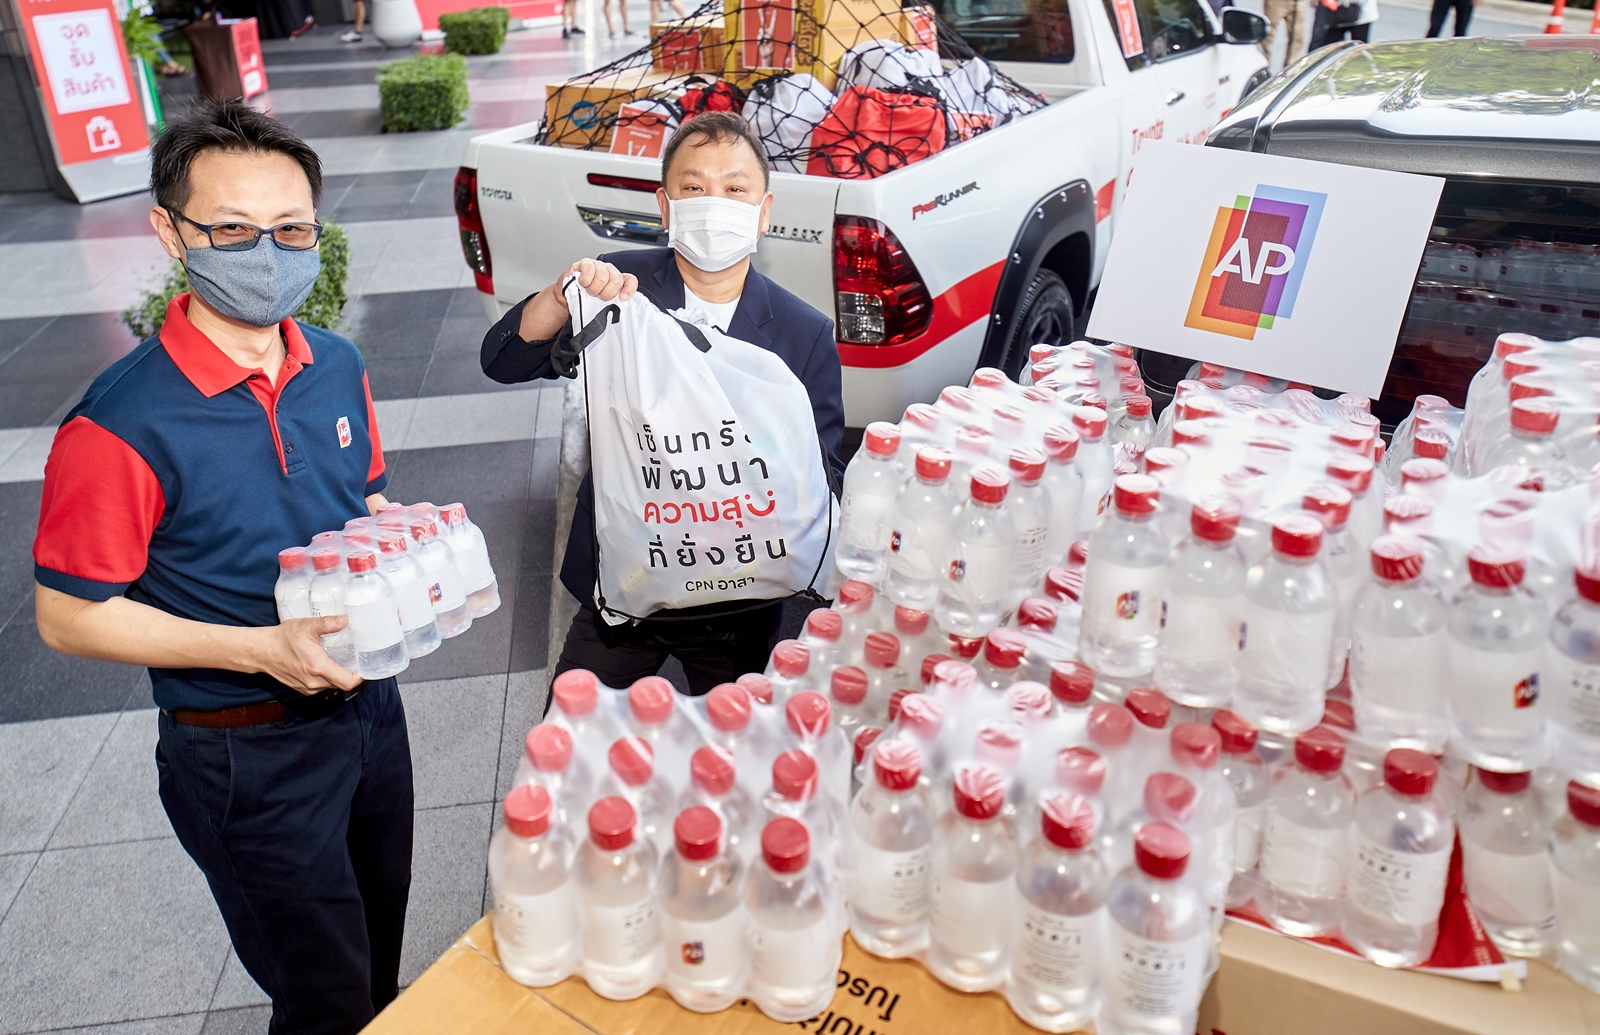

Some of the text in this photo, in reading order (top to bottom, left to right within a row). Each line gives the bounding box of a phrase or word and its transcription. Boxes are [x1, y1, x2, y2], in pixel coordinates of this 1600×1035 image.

[69, 46, 96, 68] รับ
[480, 186, 513, 201] TOYOTA
[1210, 237, 1296, 285] AP
[641, 456, 769, 491] พัฒนา
[648, 533, 787, 568] ที่ยั่งยืน
[685, 576, 755, 592] CPN อาสา
